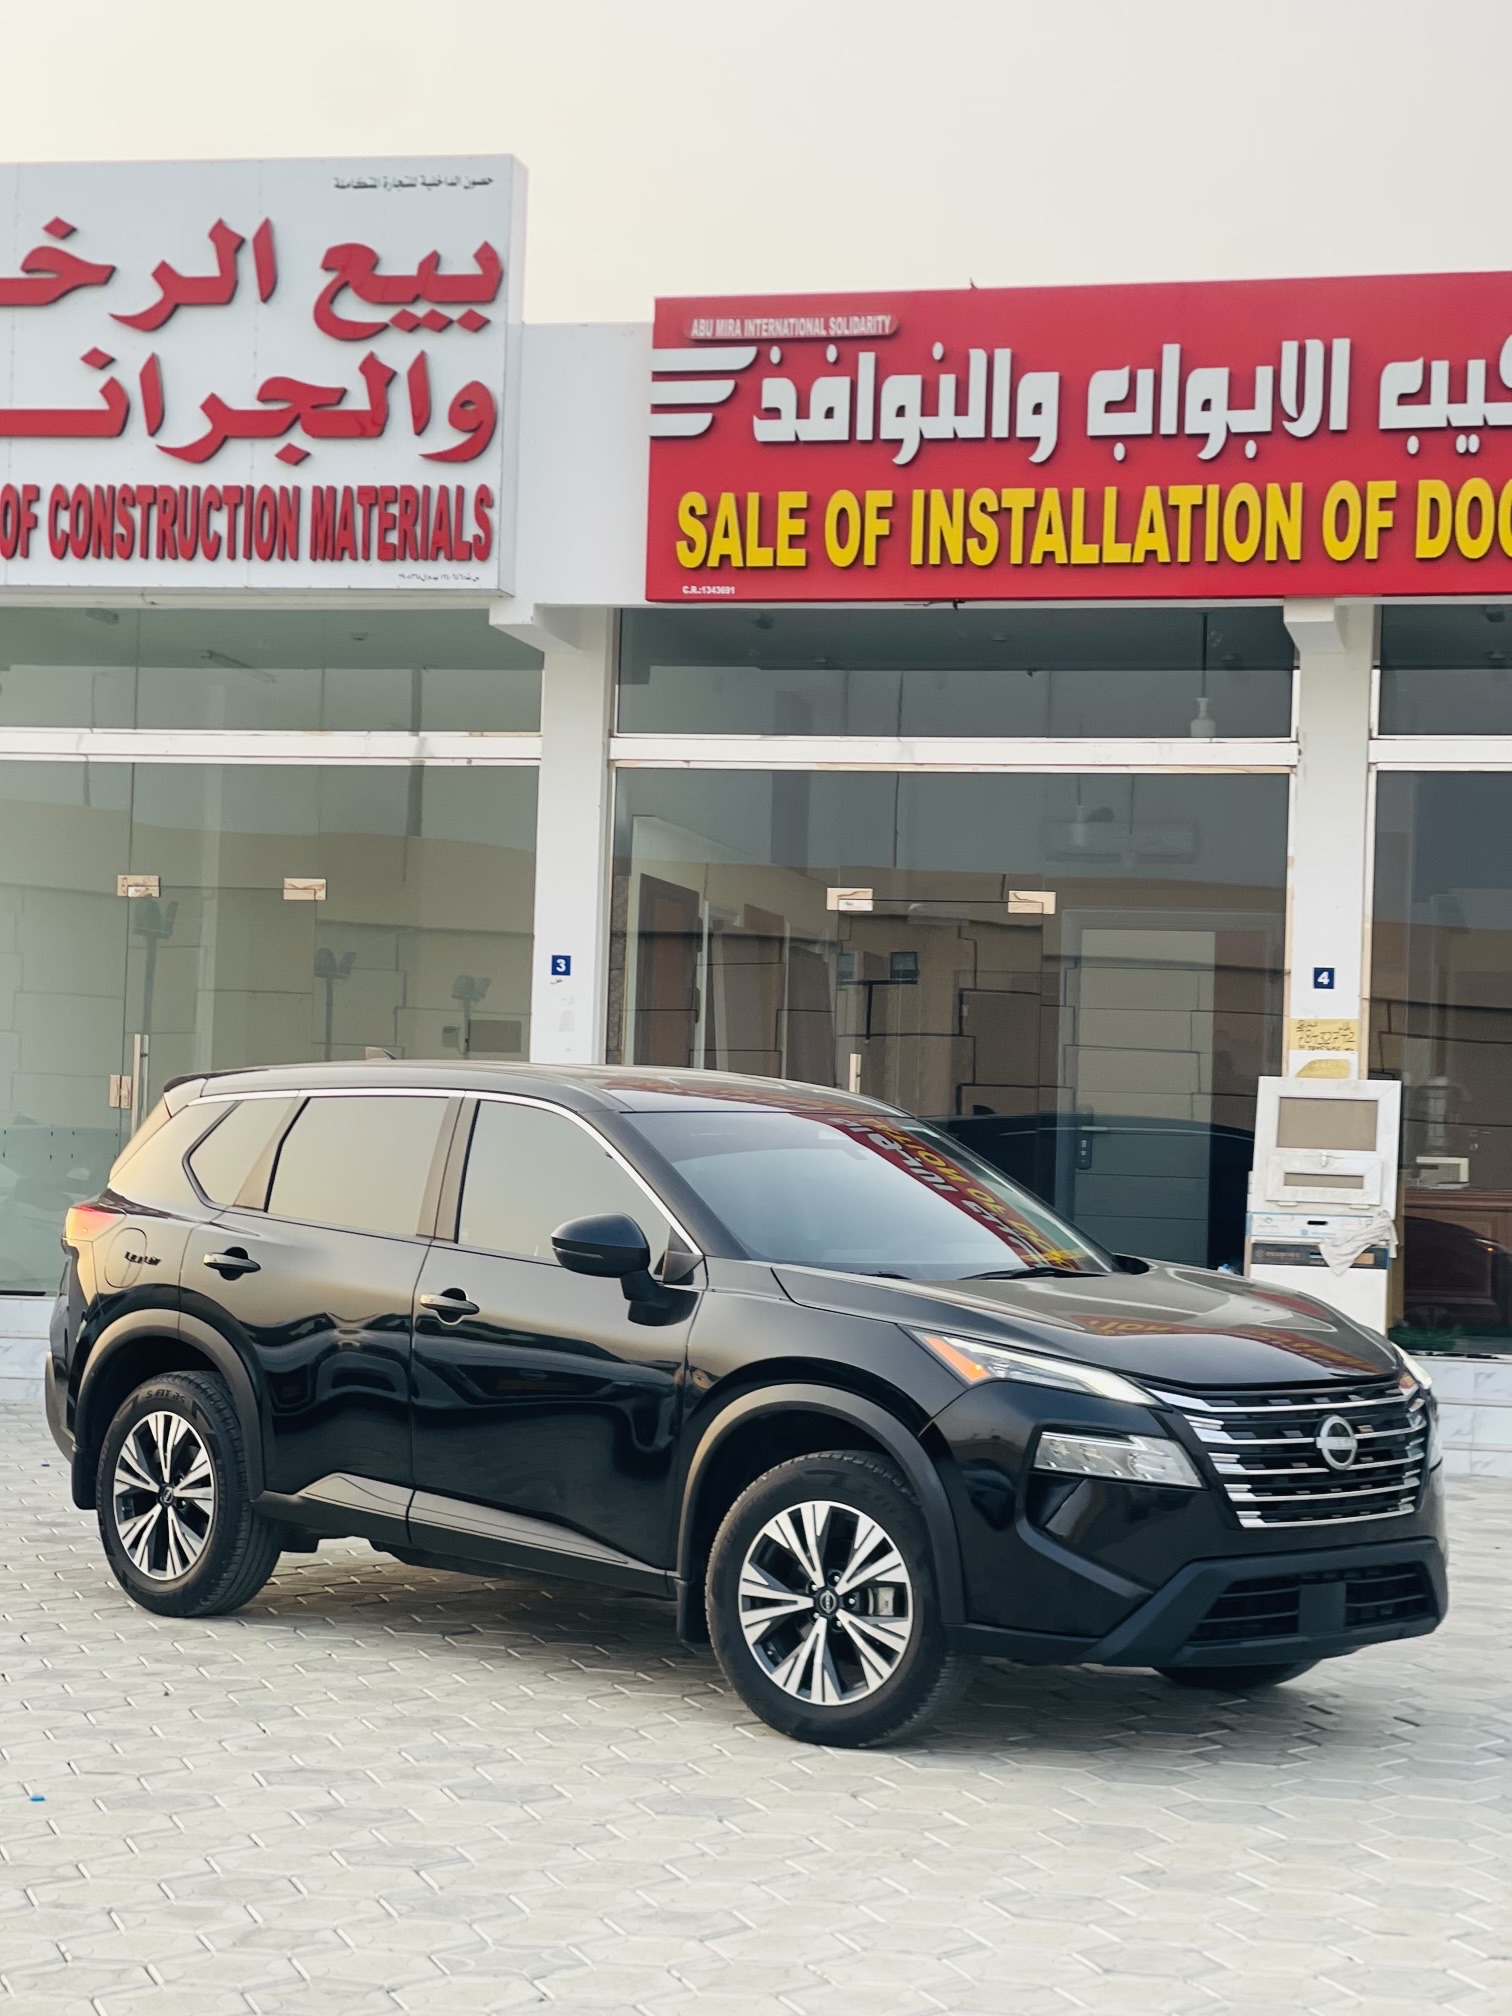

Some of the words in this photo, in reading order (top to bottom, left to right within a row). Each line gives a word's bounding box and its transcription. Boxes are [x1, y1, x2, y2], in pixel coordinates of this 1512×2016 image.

[0, 216, 278, 331] الرخ
[313, 241, 503, 341] بيع
[691, 318, 713, 337] ABU
[715, 318, 742, 337] MIRA
[744, 317, 827, 337] INTERNATIONAL
[828, 315, 892, 336] SOLIDARITY
[0, 346, 498, 465] والجران
[752, 341, 1061, 465] والنوافذ
[1087, 337, 1351, 462] الابواب
[0, 484, 40, 561] OF
[48, 484, 301, 562] CONSTRUCTION
[309, 483, 495, 563] MATERIALS
[676, 491, 808, 569] SALE
[824, 489, 894, 567] OF
[910, 482, 1303, 567] INSTALLATION
[1321, 479, 1397, 562] OF
[556, 958, 567, 972] 3
[1317, 971, 1330, 985] 4
